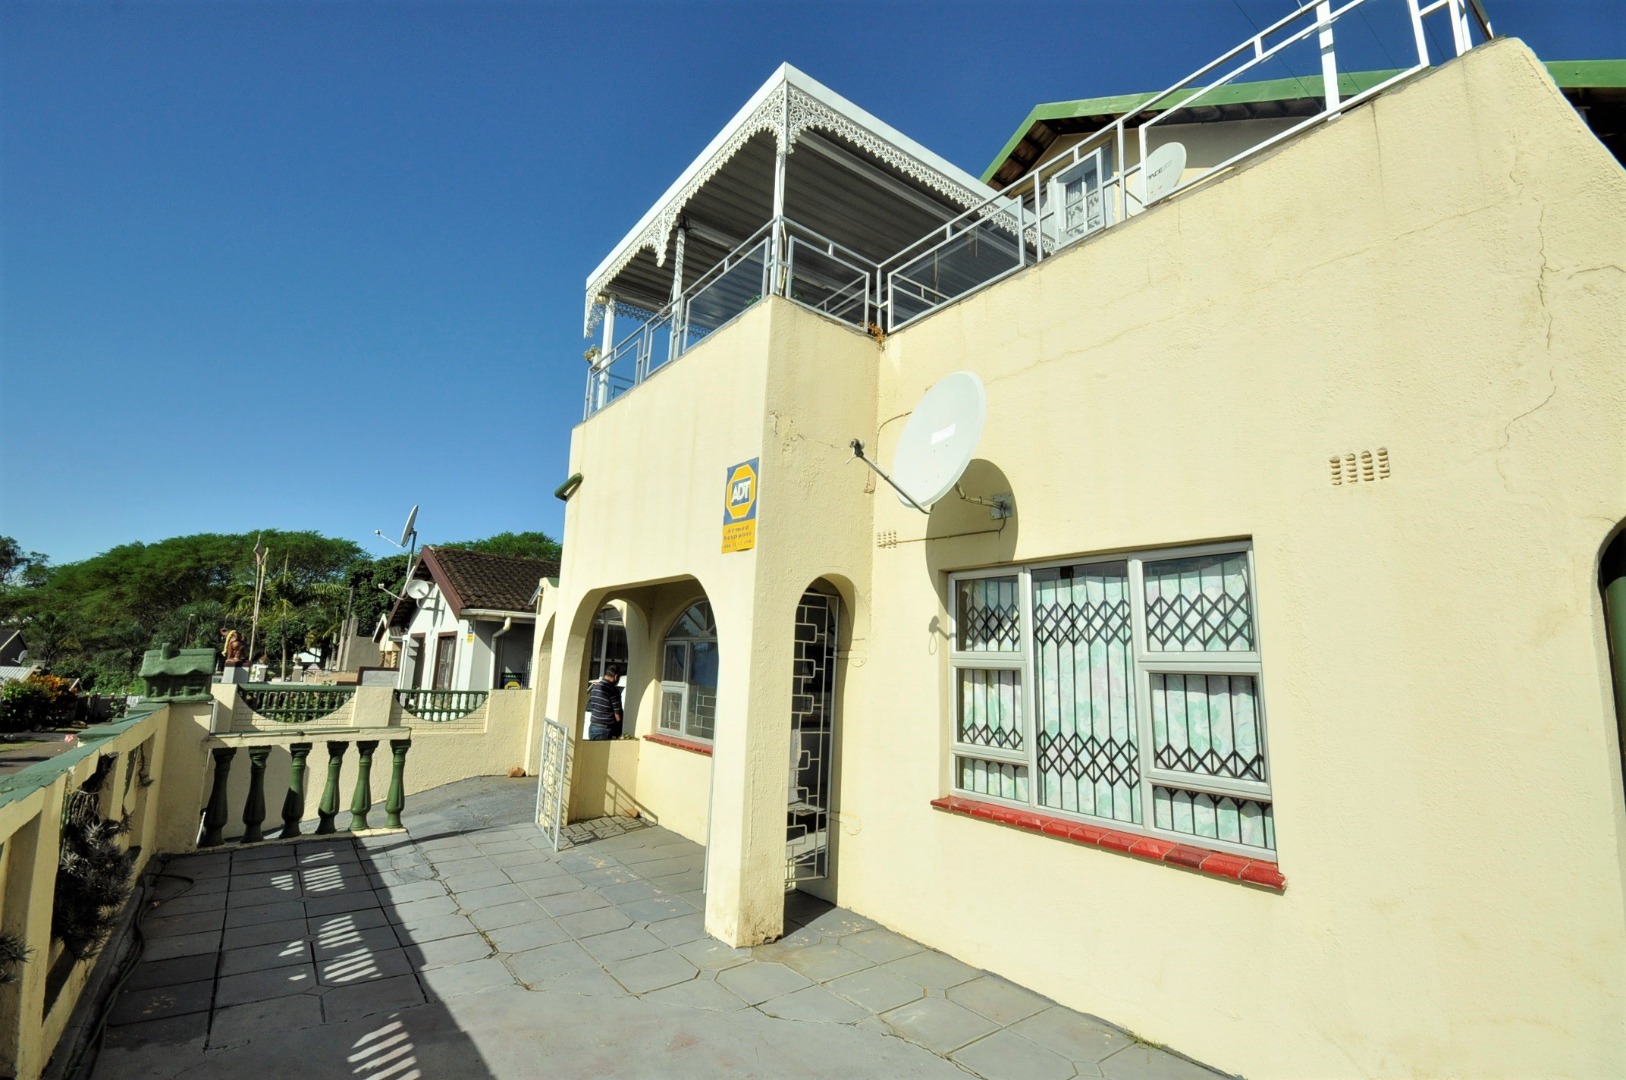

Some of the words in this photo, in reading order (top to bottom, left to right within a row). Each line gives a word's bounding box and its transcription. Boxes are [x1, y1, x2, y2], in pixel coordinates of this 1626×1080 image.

[731, 480, 751, 503] ADT
[728, 525, 749, 533] Armed
[723, 532, 752, 540] Response
